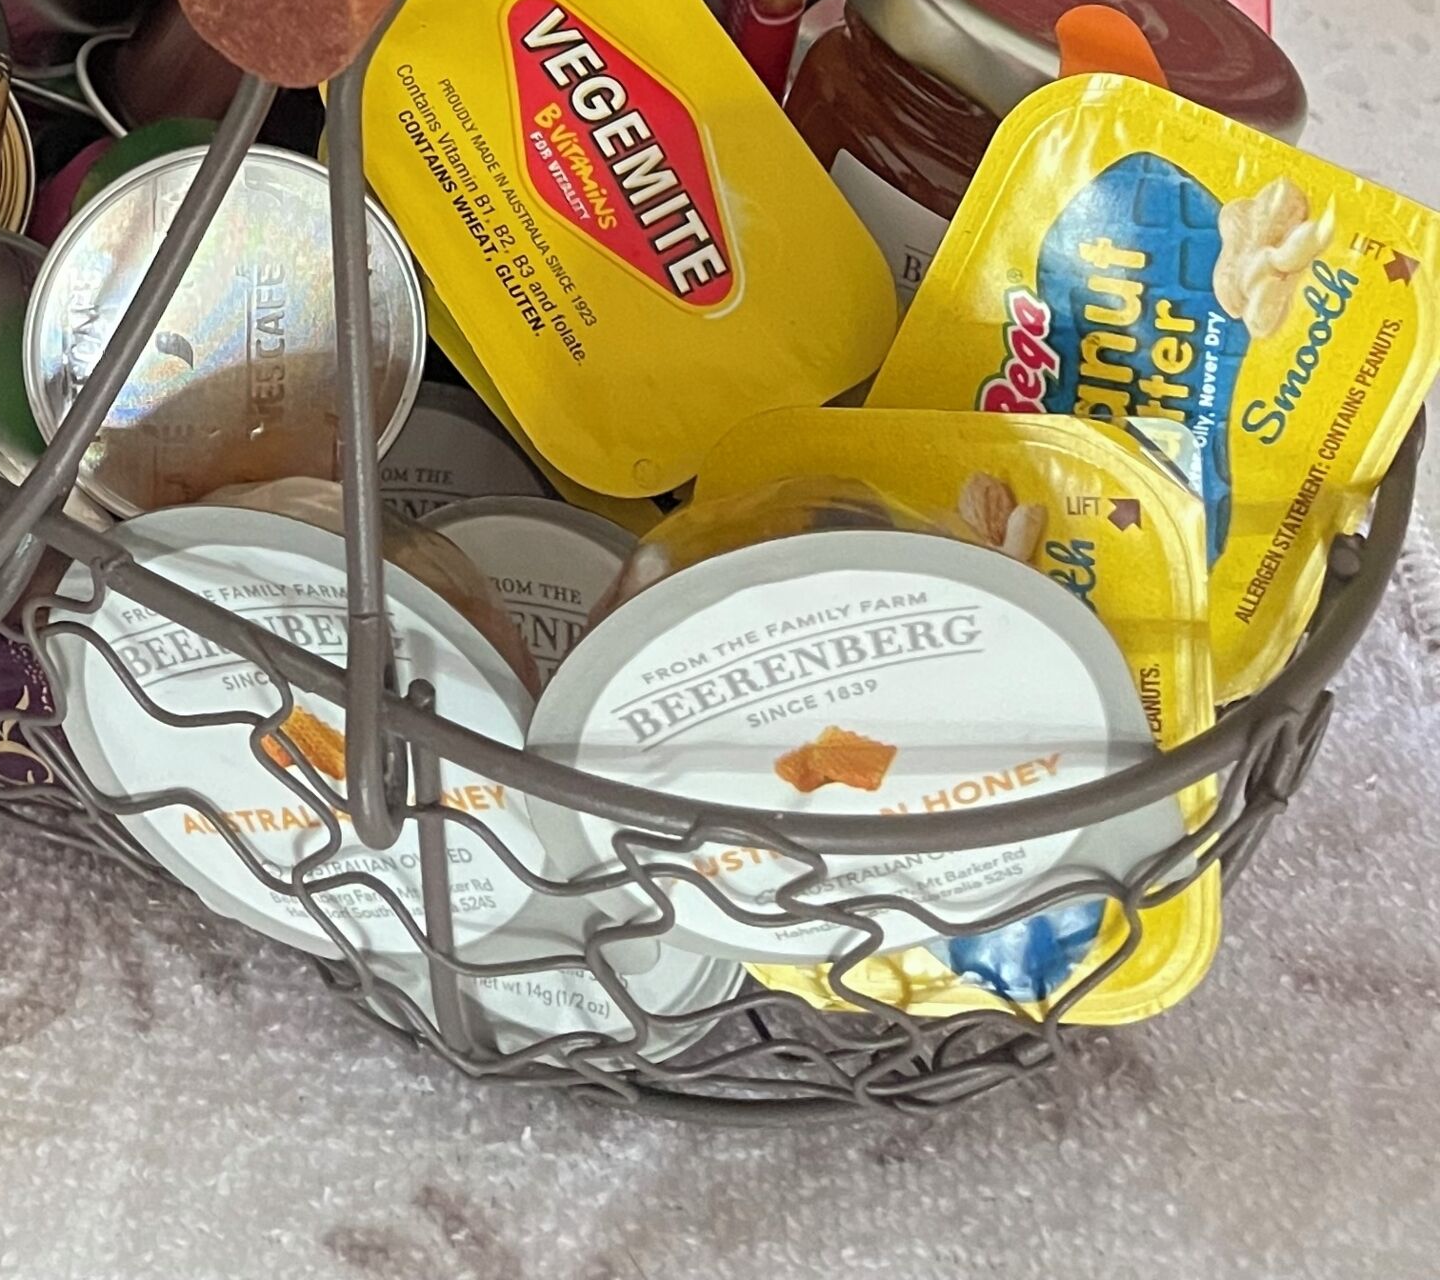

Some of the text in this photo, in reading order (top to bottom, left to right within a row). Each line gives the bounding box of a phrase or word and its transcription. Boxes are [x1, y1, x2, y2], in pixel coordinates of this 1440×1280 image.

[534, 102, 562, 130] B
[521, 4, 729, 297] VEGEMITE
[530, 130, 591, 221] FOR VITALITY
[396, 63, 442, 133] Contains
[438, 131, 479, 194] Vitamin
[513, 253, 536, 282] B3
[529, 278, 558, 313] and
[550, 311, 587, 367] folate.
[398, 108, 548, 338] CONTAINS WHEAT, GLUTEN.
[439, 78, 598, 328] PROUDLY MADE IN AUSTRALIA SINCE 1923
[1204, 311, 1227, 347] Dry
[1241, 259, 1360, 447] Smooth
[1199, 353, 1220, 409] Never
[415, 468, 456, 485] THE
[1235, 317, 1404, 626] ALLERGEN STATEMENT: CONTAINS PEANUTS.
[1066, 496, 1101, 517] LIFT
[221, 582, 287, 603] FAMILY
[538, 583, 583, 606] THE
[641, 590, 929, 686] FROM THE FAMILY FARM
[618, 613, 983, 743] BEERENBERG
[746, 678, 879, 729] SINCE 1839
[921, 751, 1062, 815] HONEY
[944, 857, 999, 883] Barker
[1002, 845, 1027, 863] Rd
[526, 981, 553, 1006] 14g
